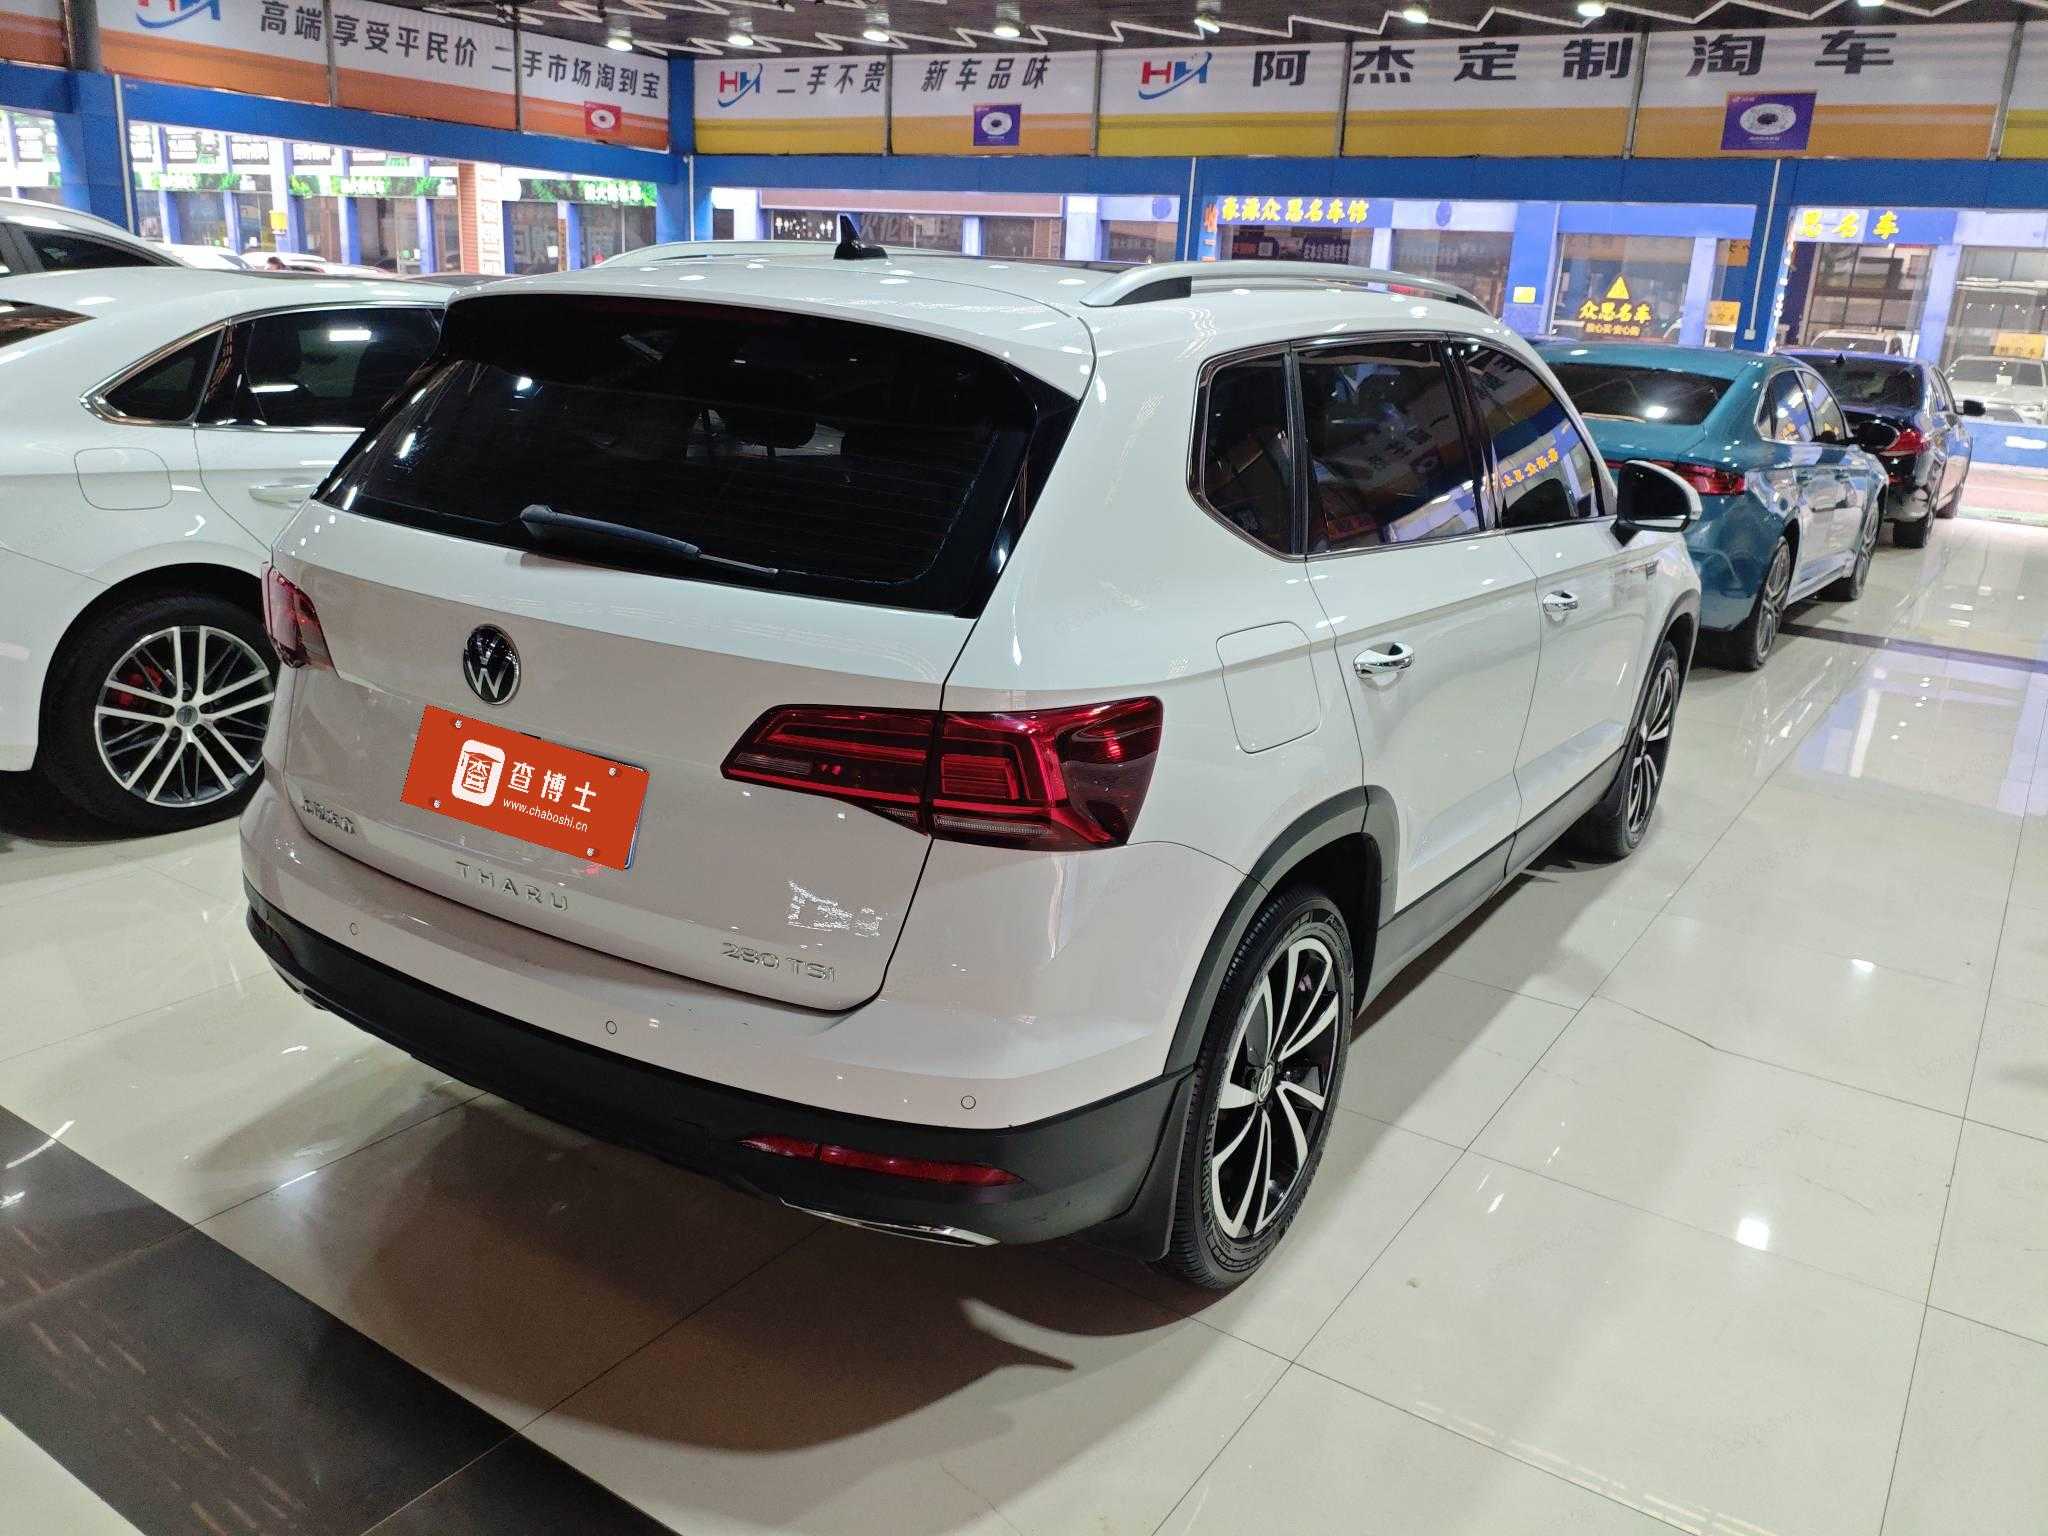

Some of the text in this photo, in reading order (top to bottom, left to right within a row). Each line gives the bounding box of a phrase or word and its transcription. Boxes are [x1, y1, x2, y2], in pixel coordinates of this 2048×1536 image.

[260, 0, 477, 68] 高端享受平民价
[491, 45, 661, 100] 二手市场淘到宝
[1253, 30, 1897, 87] 阿杰定制淘车
[777, 54, 1051, 97] 二手不贵 新车品味
[456, 861, 569, 911] THARU
[720, 942, 838, 984] 280 TSI
